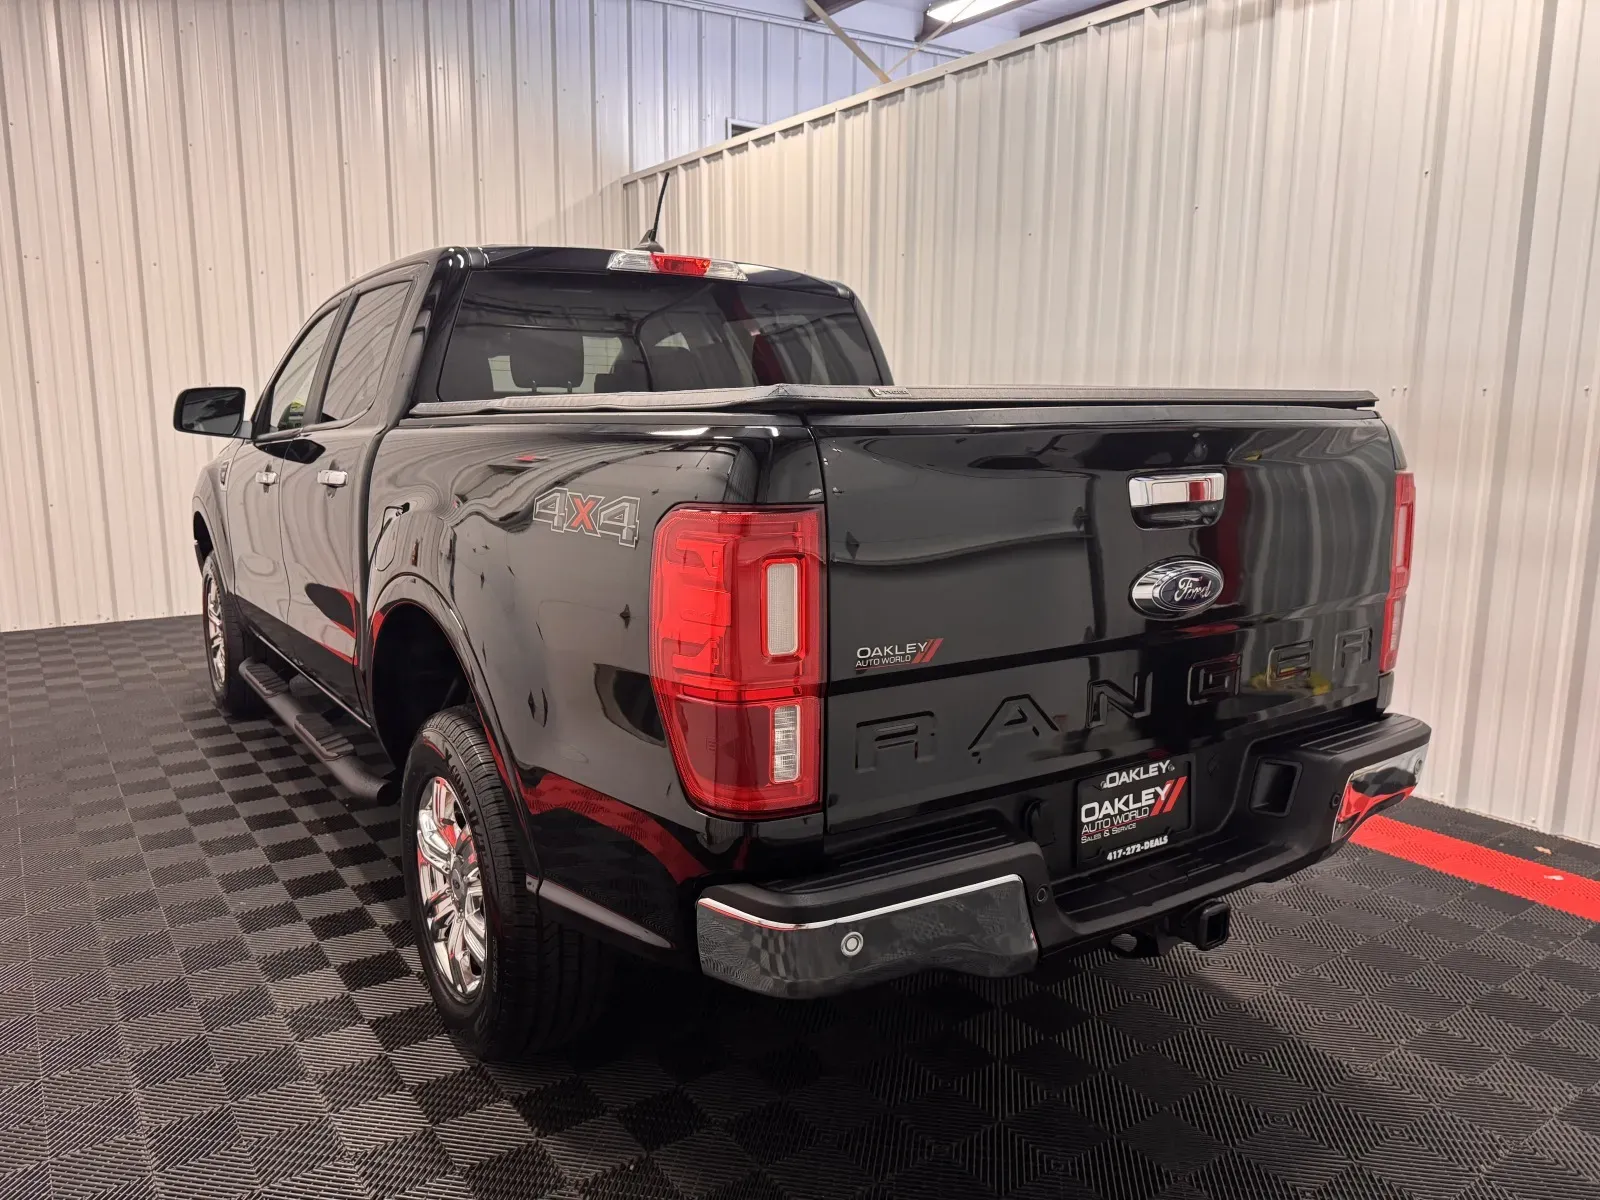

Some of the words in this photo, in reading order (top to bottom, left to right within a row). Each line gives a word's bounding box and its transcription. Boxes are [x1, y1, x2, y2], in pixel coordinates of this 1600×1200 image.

[1174, 576, 1212, 602] Ford
[855, 658, 880, 667] AUTO
[881, 654, 911, 664] WORLD
[856, 641, 929, 659] OAKLEY
[855, 625, 1374, 774] RANGER
[1105, 759, 1171, 789] OAKLEY
[1081, 783, 1172, 823] OAKLEY
[1081, 818, 1111, 835] AUTO
[1112, 807, 1149, 825] WORLD
[1106, 835, 1169, 861] 417-272-DEALS
